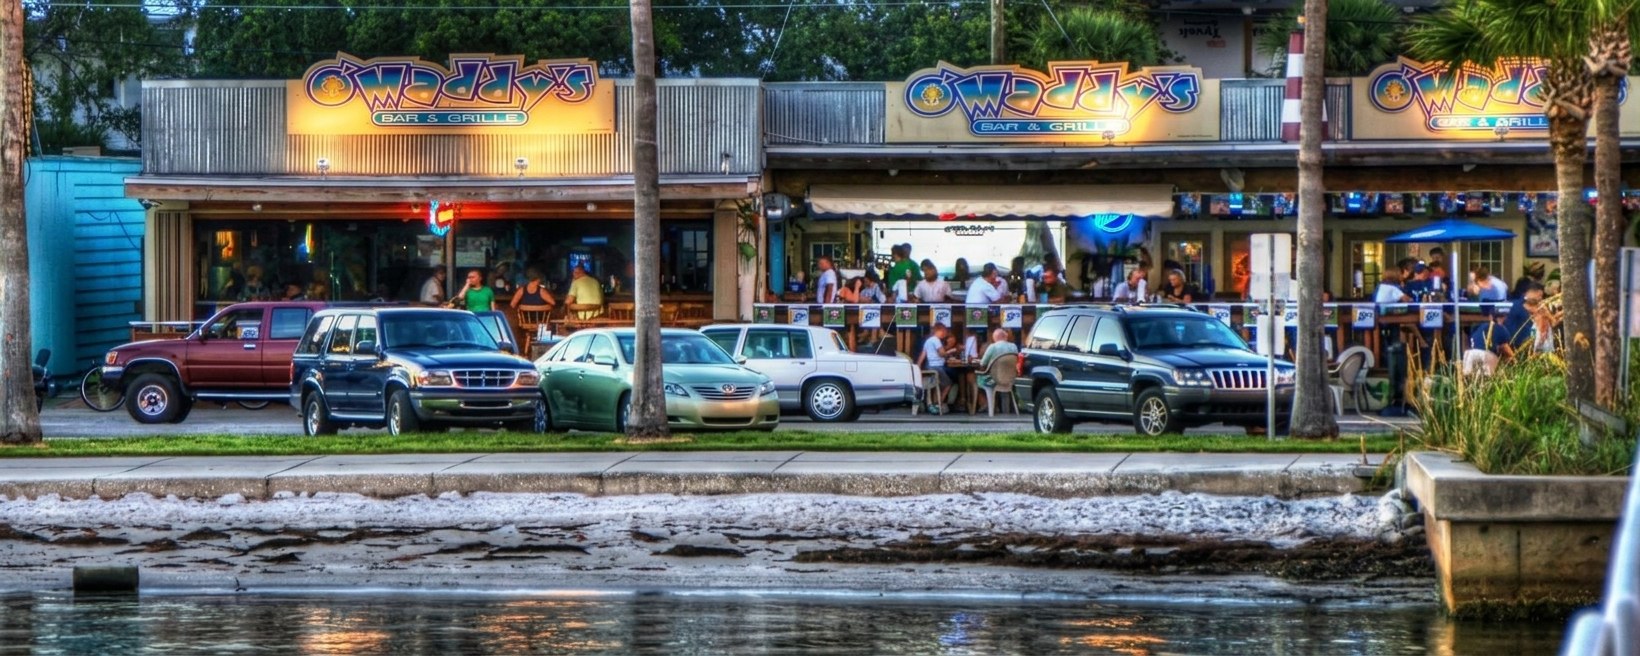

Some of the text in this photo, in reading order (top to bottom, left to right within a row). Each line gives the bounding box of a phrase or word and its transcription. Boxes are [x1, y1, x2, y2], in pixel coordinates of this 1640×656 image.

[381, 114, 519, 122] BAR & GRILLE
[1495, 117, 1548, 127] GRILL
[981, 122, 1119, 132] BAR & GRILL
